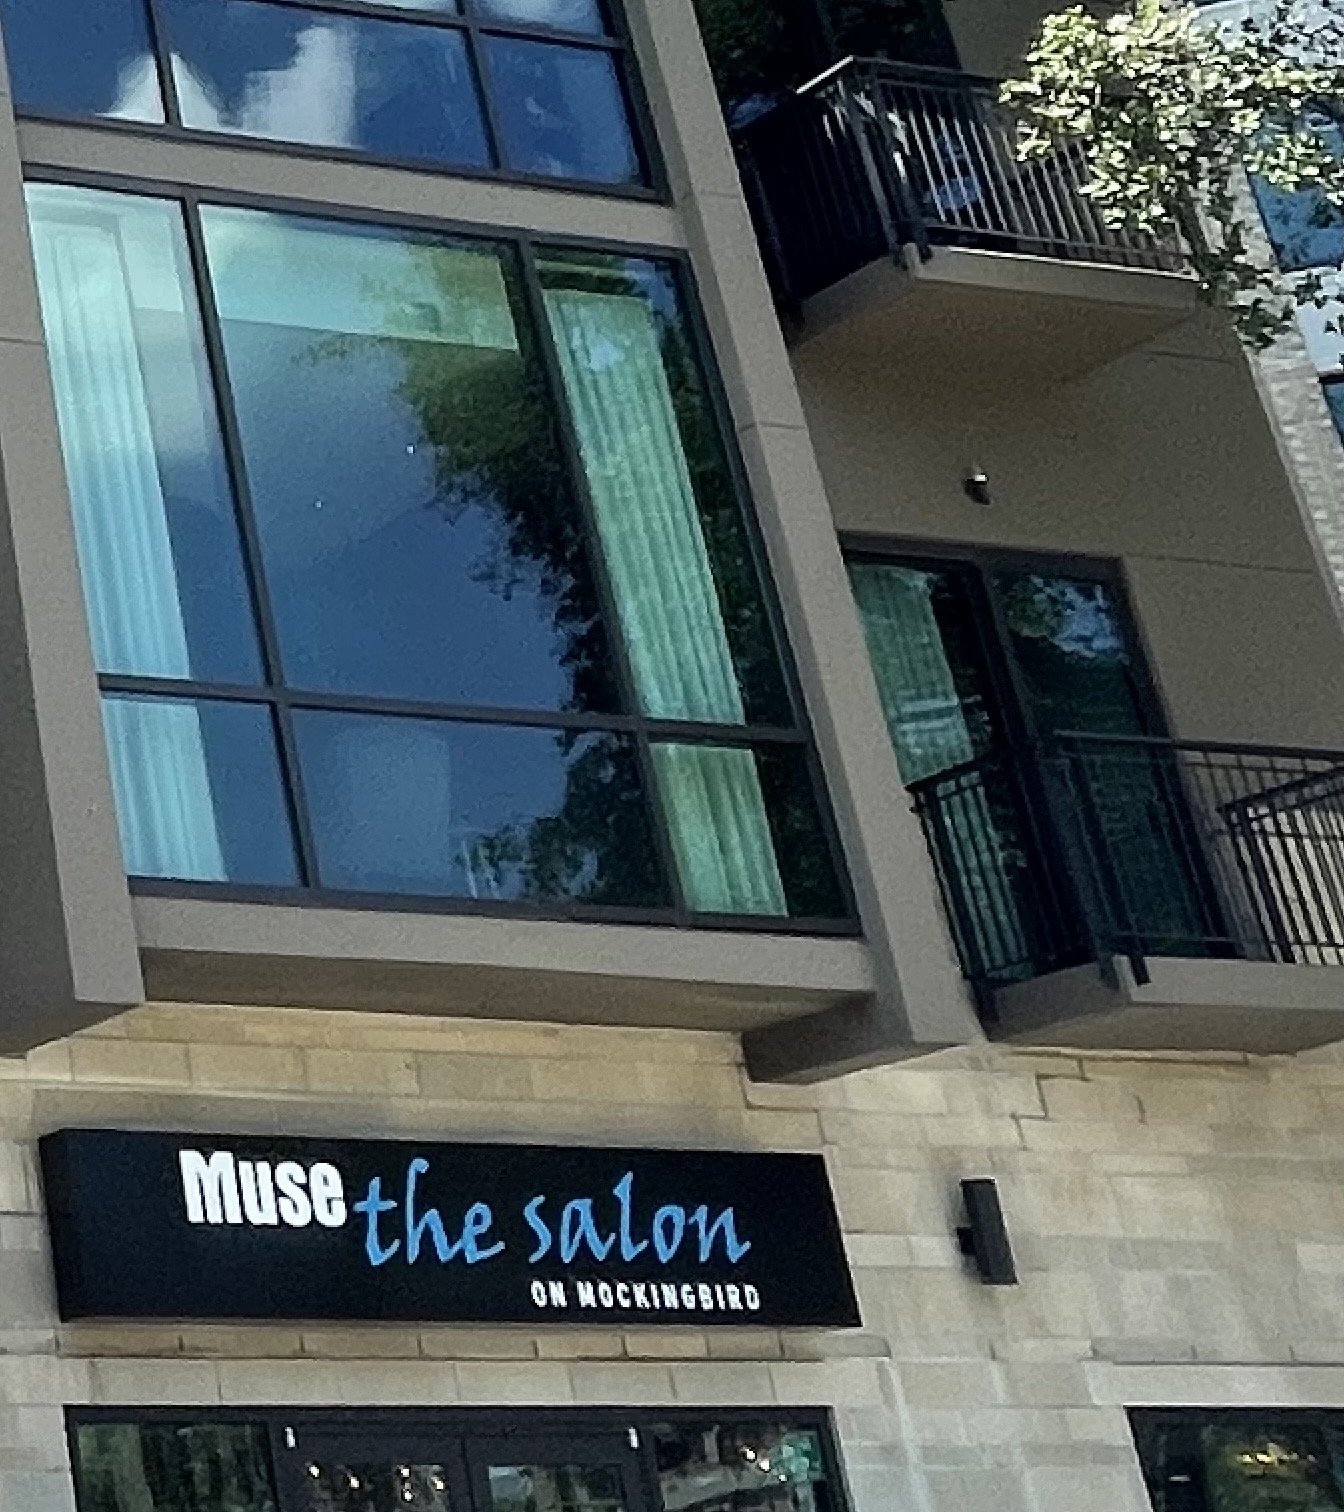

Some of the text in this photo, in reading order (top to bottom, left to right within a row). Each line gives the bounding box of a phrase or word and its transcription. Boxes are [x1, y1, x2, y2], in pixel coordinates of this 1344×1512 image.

[178, 1149, 752, 1267] Muse the salon
[530, 1279, 761, 1312] ON MOCKINGBIRD
